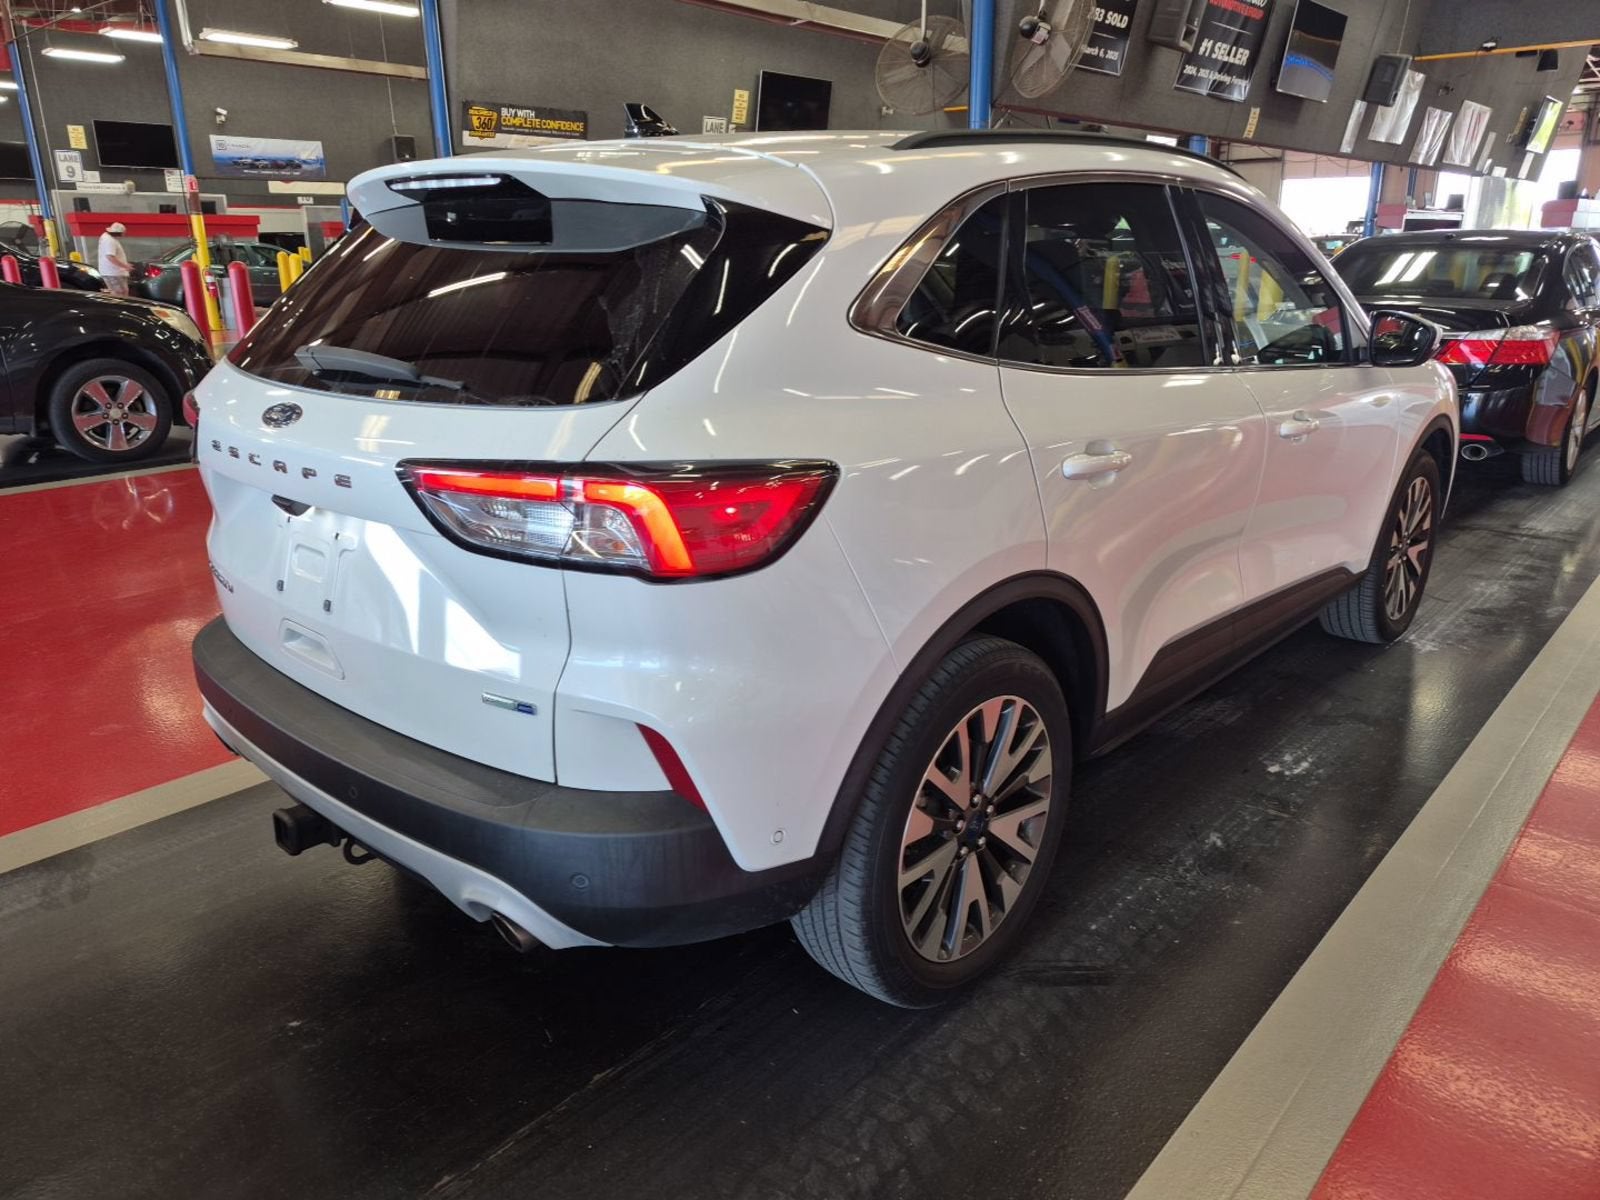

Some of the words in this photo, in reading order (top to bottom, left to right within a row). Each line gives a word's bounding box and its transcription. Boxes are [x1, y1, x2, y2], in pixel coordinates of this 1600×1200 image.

[1105, 11, 1129, 28] SOLD
[1198, 38, 1213, 57] #1
[1211, 42, 1250, 66] SELLER
[501, 107, 516, 118] BUY
[515, 109, 536, 119] WITH
[475, 116, 492, 130] 360
[501, 117, 541, 129] COMPLETE
[541, 120, 584, 132] CONFIDENCE
[705, 120, 726, 134] LANE
[58, 153, 80, 163] LANE
[65, 165, 76, 178] 9
[211, 439, 352, 489] ESCAPE
